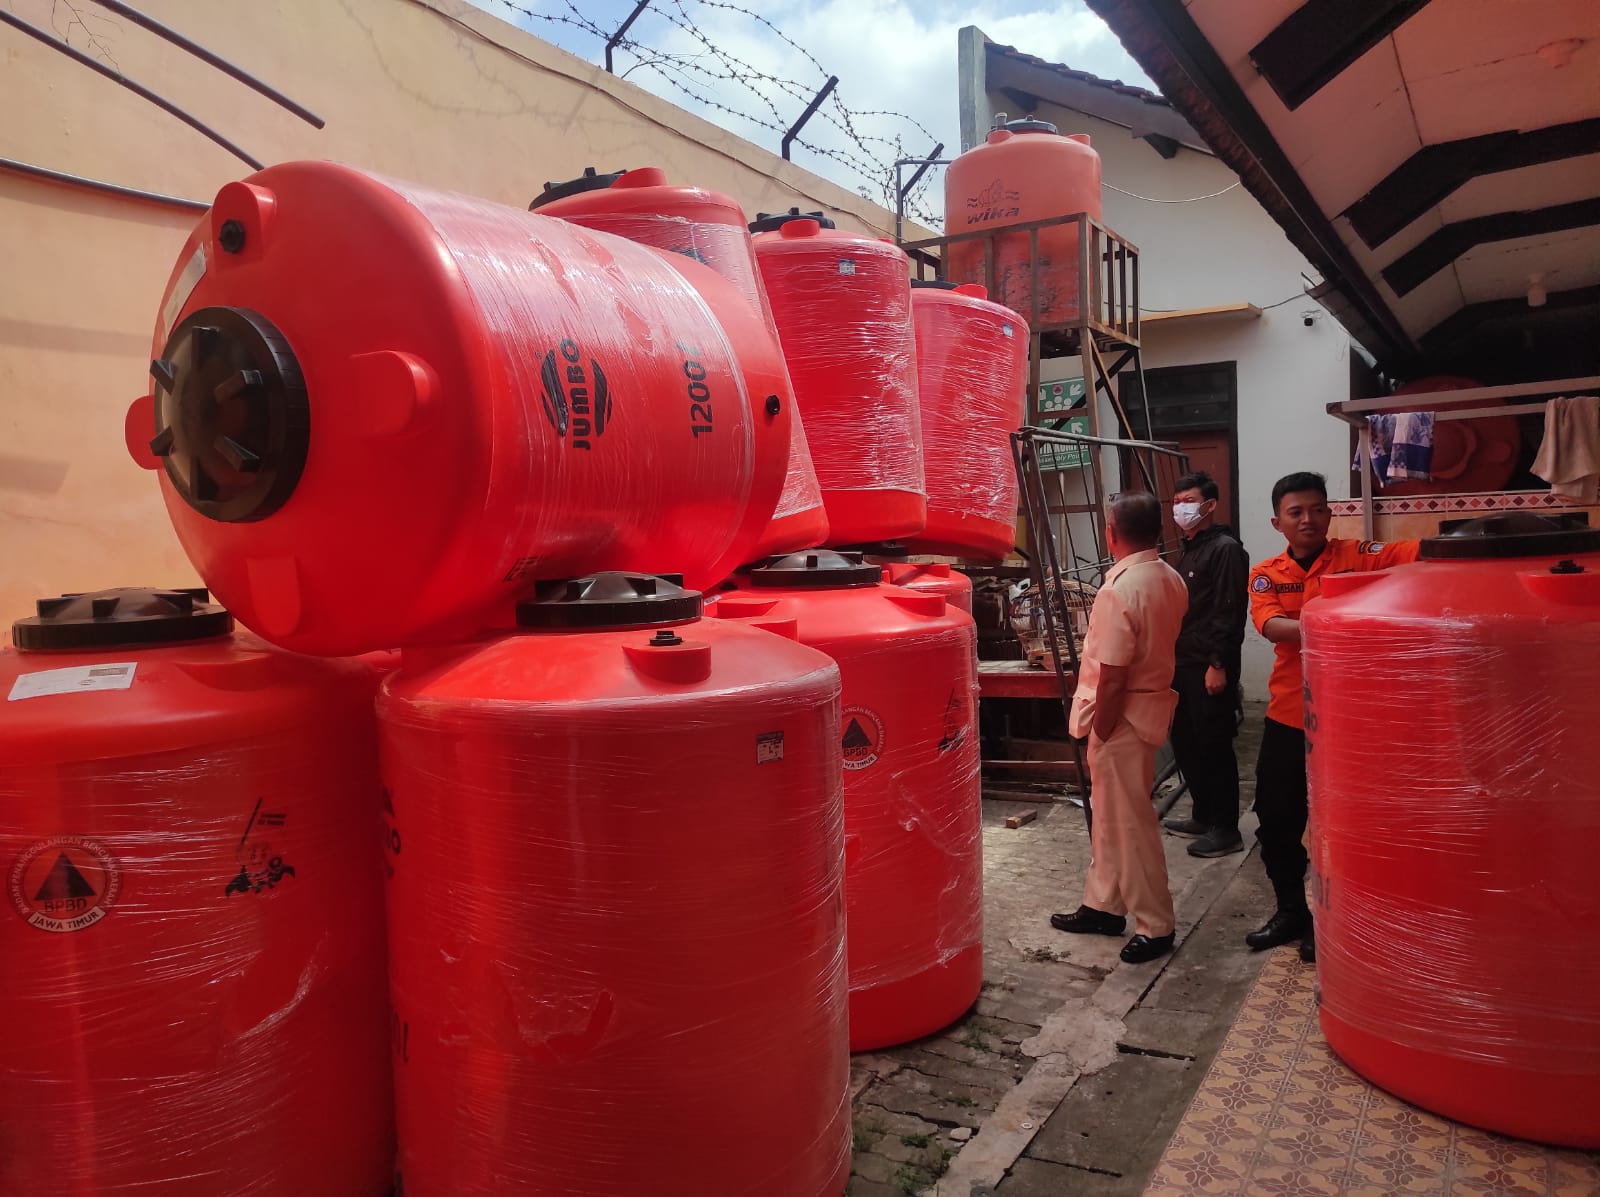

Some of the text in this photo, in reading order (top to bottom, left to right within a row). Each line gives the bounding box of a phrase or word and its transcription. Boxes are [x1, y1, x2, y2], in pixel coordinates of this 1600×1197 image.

[967, 207, 1020, 225] wika
[560, 338, 592, 451] JUMBO
[857, 756, 875, 768] TIMUR
[44, 897, 88, 912] BPBD
[33, 911, 99, 930] JAWA TIMUR
